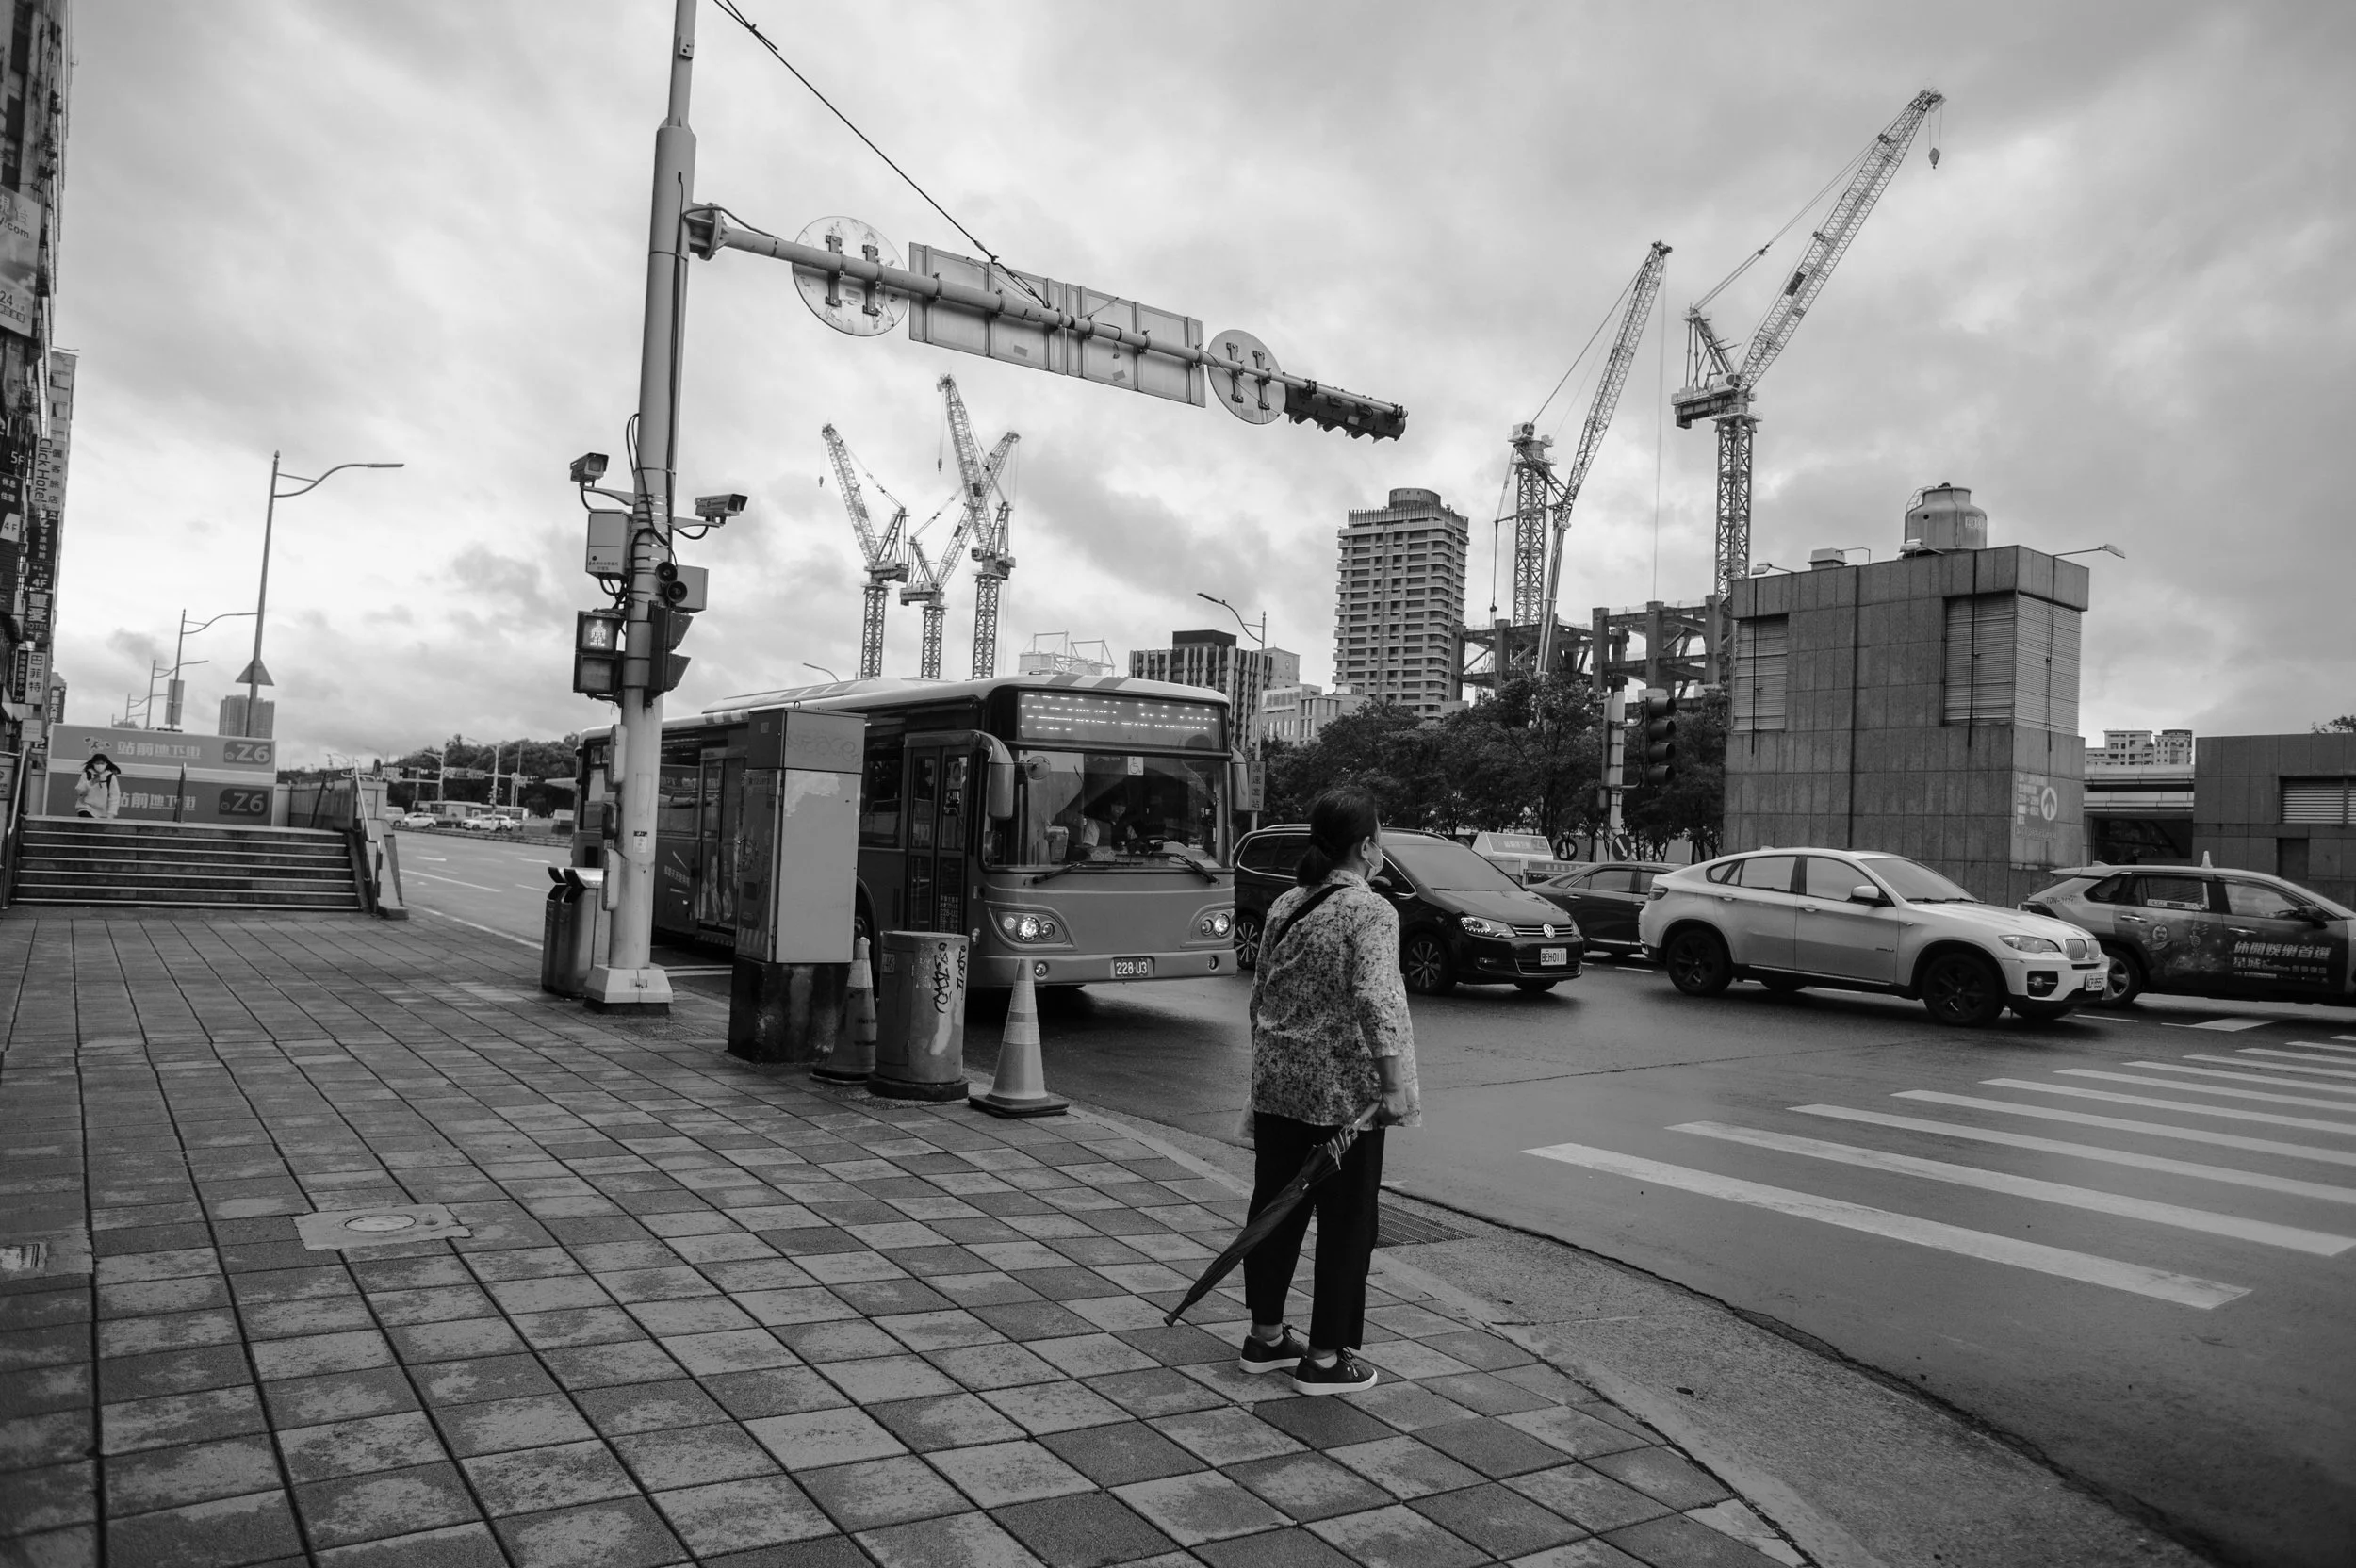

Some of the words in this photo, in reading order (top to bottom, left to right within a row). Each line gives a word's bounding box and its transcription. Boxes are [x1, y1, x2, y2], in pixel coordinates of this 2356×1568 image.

[10, 450, 25, 466] 5F
[38, 437, 53, 466] Click
[34, 469, 50, 503] Hotel
[28, 654, 43, 694] 巴菲特
[236, 743, 270, 762] Z6
[231, 792, 265, 812] Z6
